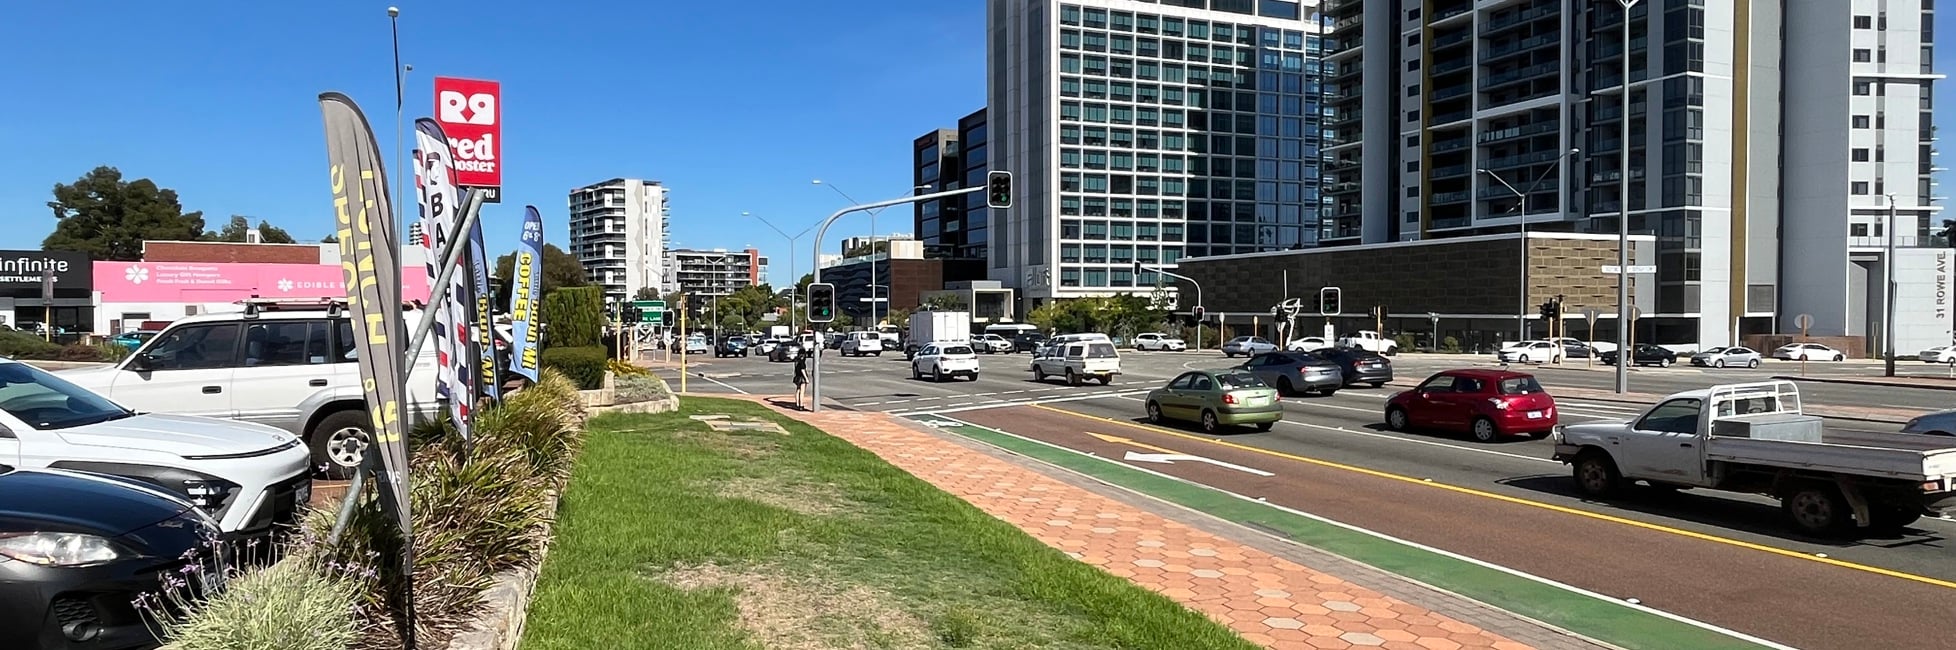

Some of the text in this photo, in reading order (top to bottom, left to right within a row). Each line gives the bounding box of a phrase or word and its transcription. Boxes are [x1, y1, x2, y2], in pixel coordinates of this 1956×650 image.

[447, 133, 495, 160] red
[0, 257, 69, 275] infinite
[0, 275, 58, 283] SETTLEMES
[297, 281, 335, 289] EDIBLE
[514, 252, 532, 321] COFFEE
[1936, 275, 1946, 305] ROWE
[1936, 308, 1945, 319] 31
[521, 346, 537, 369] Mi
[481, 356, 495, 385] Mi
